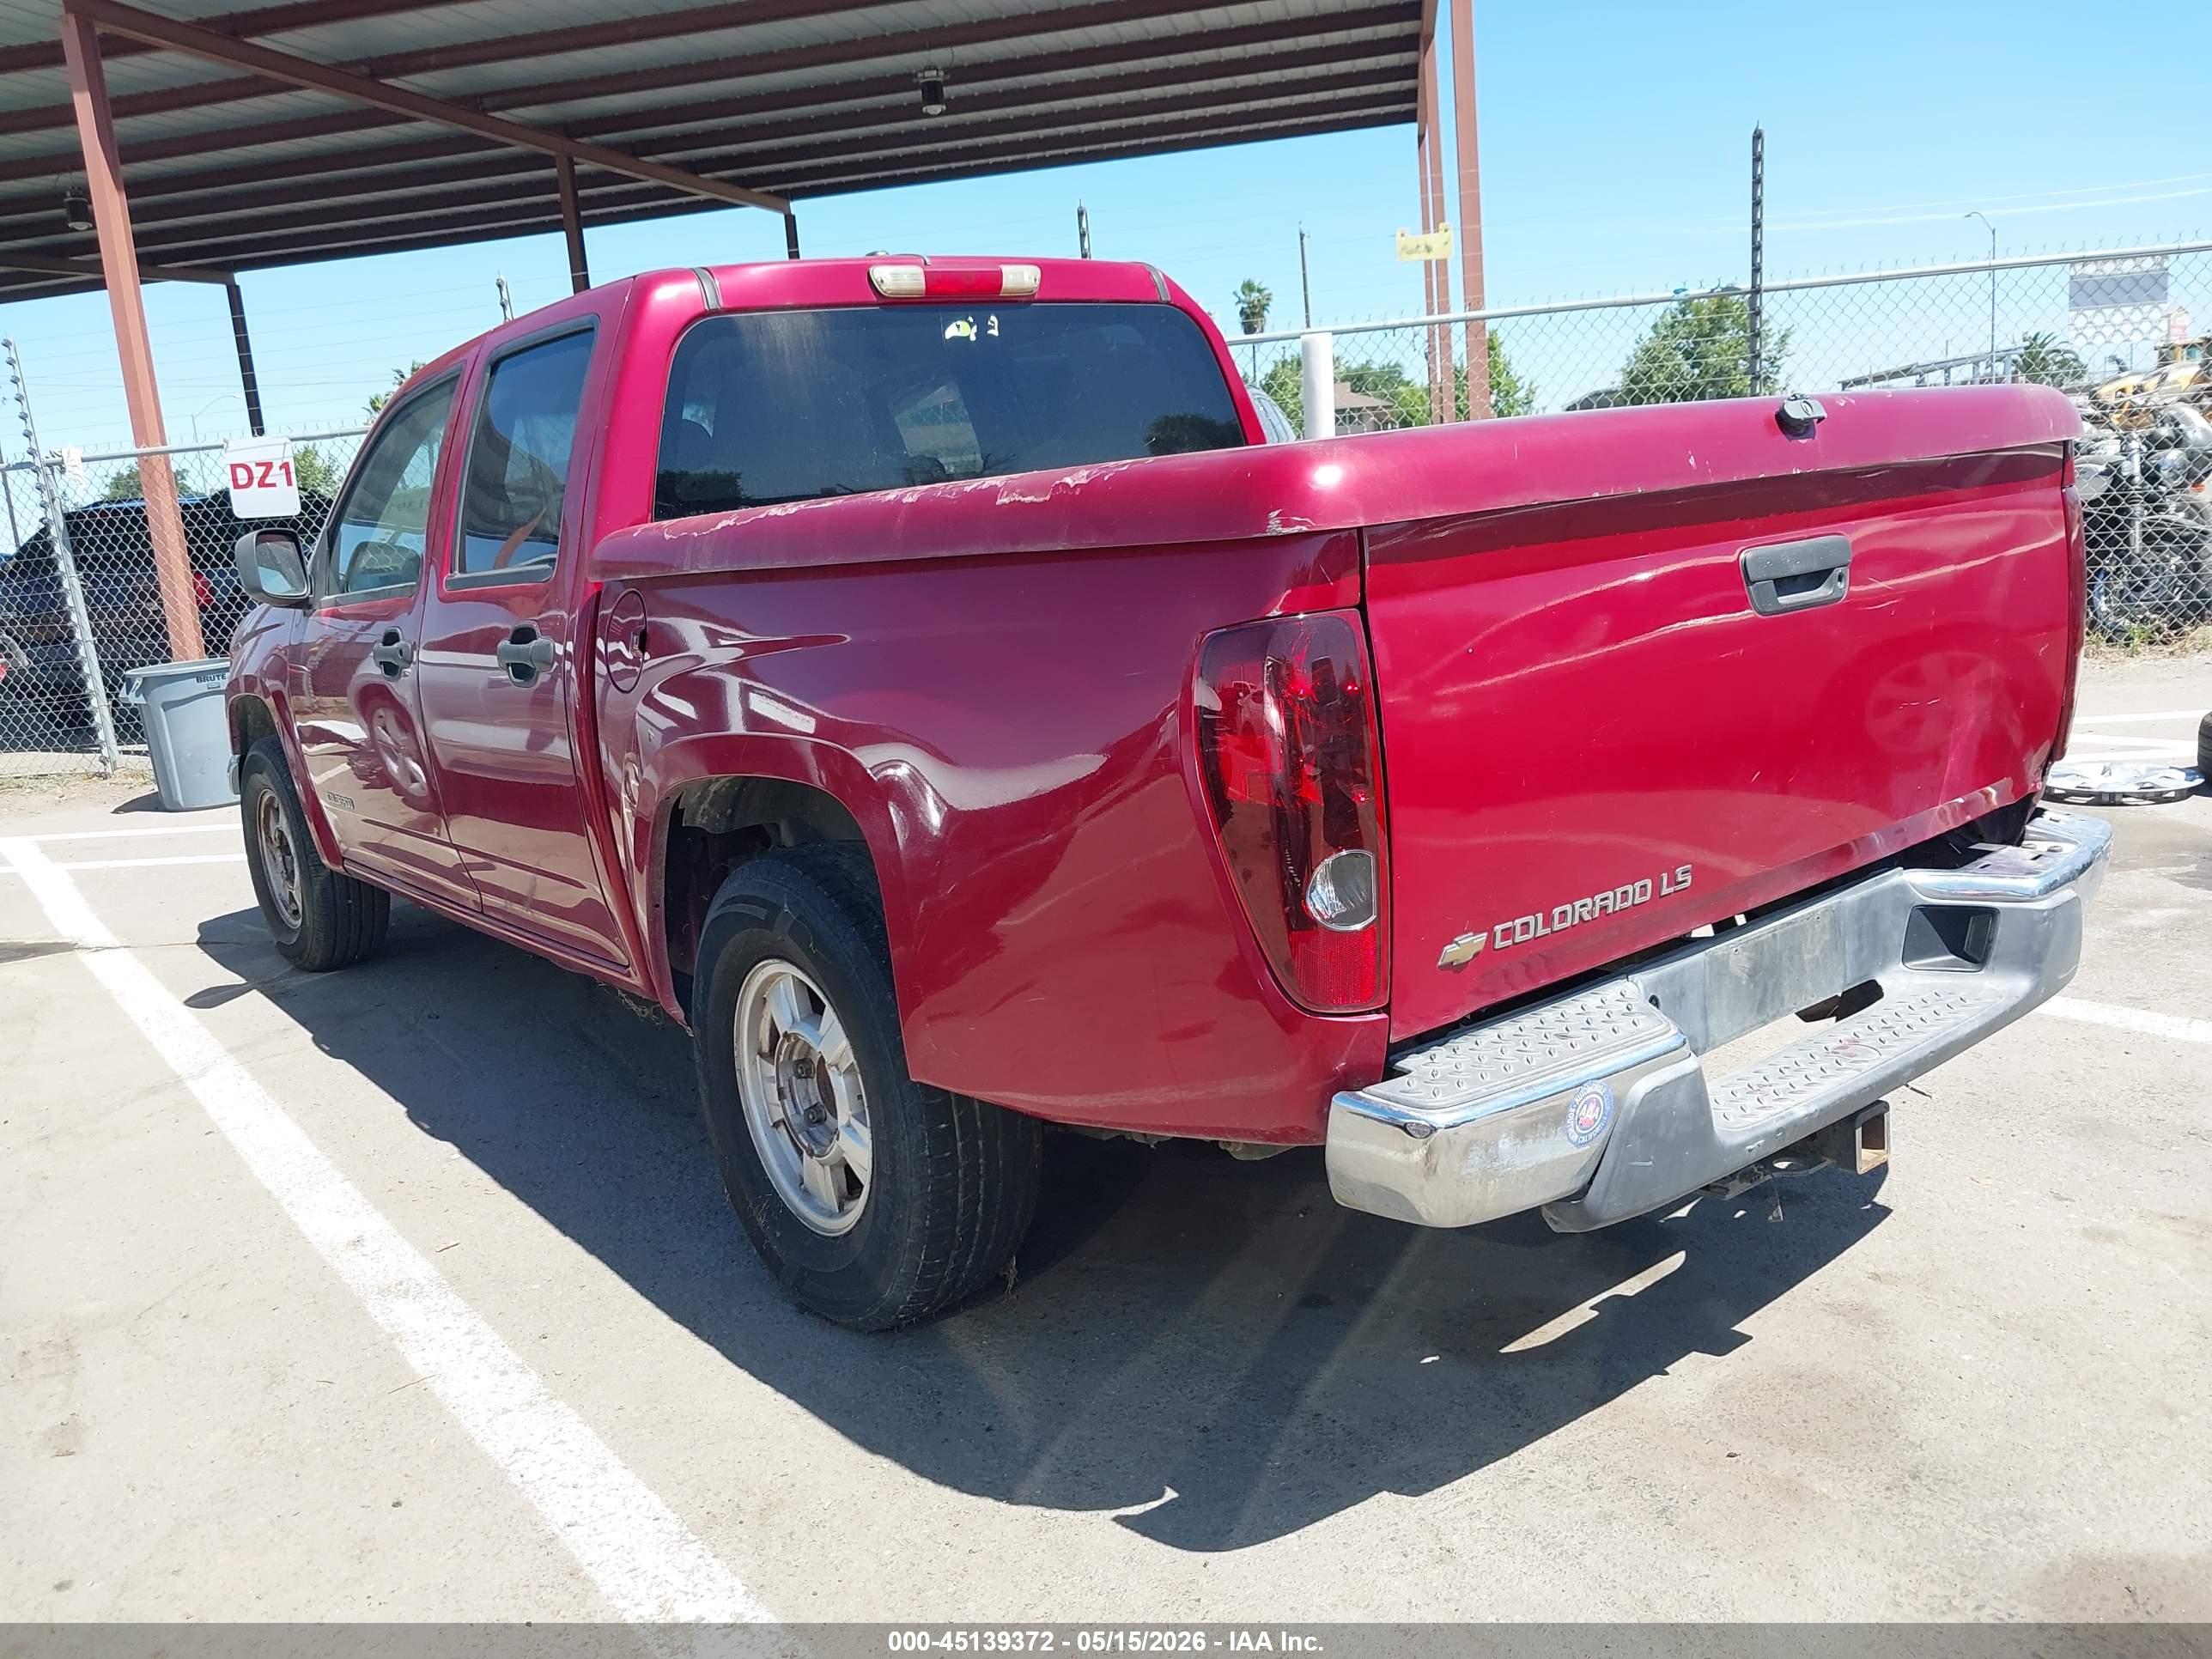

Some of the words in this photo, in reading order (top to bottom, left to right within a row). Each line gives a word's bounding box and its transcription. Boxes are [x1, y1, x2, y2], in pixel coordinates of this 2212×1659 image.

[229, 461, 293, 489] DZ1
[196, 673, 227, 684] BRUTE
[1492, 878, 1652, 950] COLORADO
[1659, 864, 1692, 899] LS
[1579, 1103, 1600, 1120] AAA
